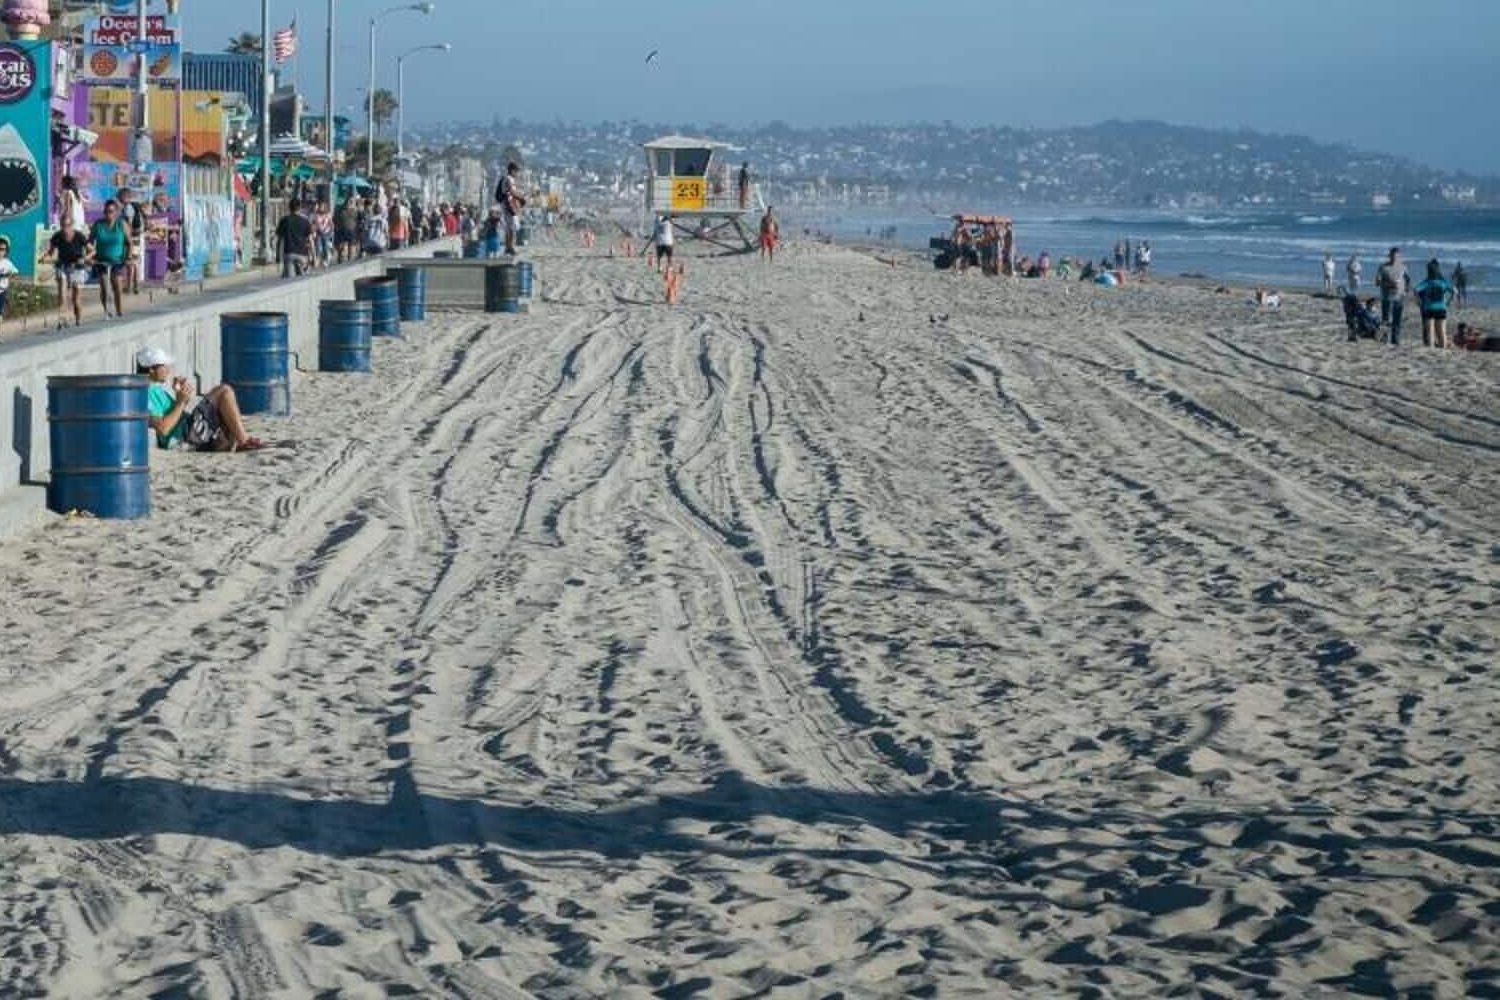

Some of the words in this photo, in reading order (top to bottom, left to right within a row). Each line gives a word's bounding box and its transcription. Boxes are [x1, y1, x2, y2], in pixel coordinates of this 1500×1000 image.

[93, 32, 117, 45] Ice
[121, 31, 172, 45] Cram
[676, 183, 699, 197] 23
